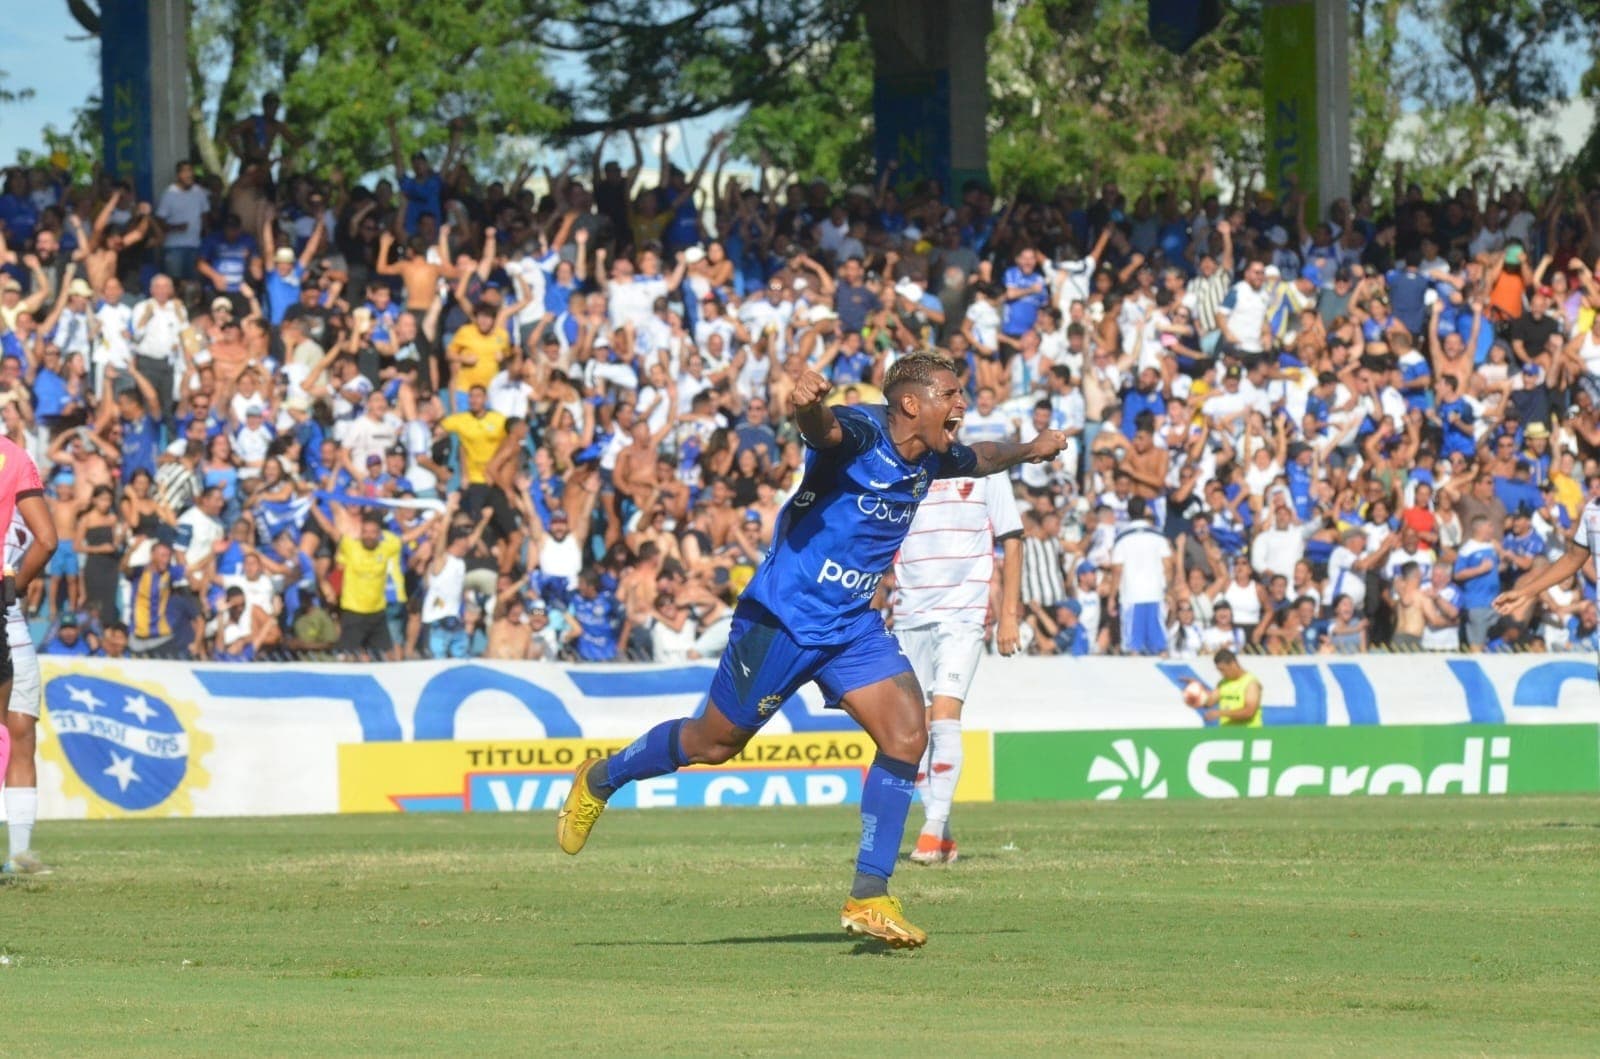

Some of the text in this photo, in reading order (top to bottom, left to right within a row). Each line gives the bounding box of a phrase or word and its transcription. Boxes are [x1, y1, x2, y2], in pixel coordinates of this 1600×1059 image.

[466, 745, 574, 767] TÍTULO
[487, 774, 848, 812] VAE CAP
